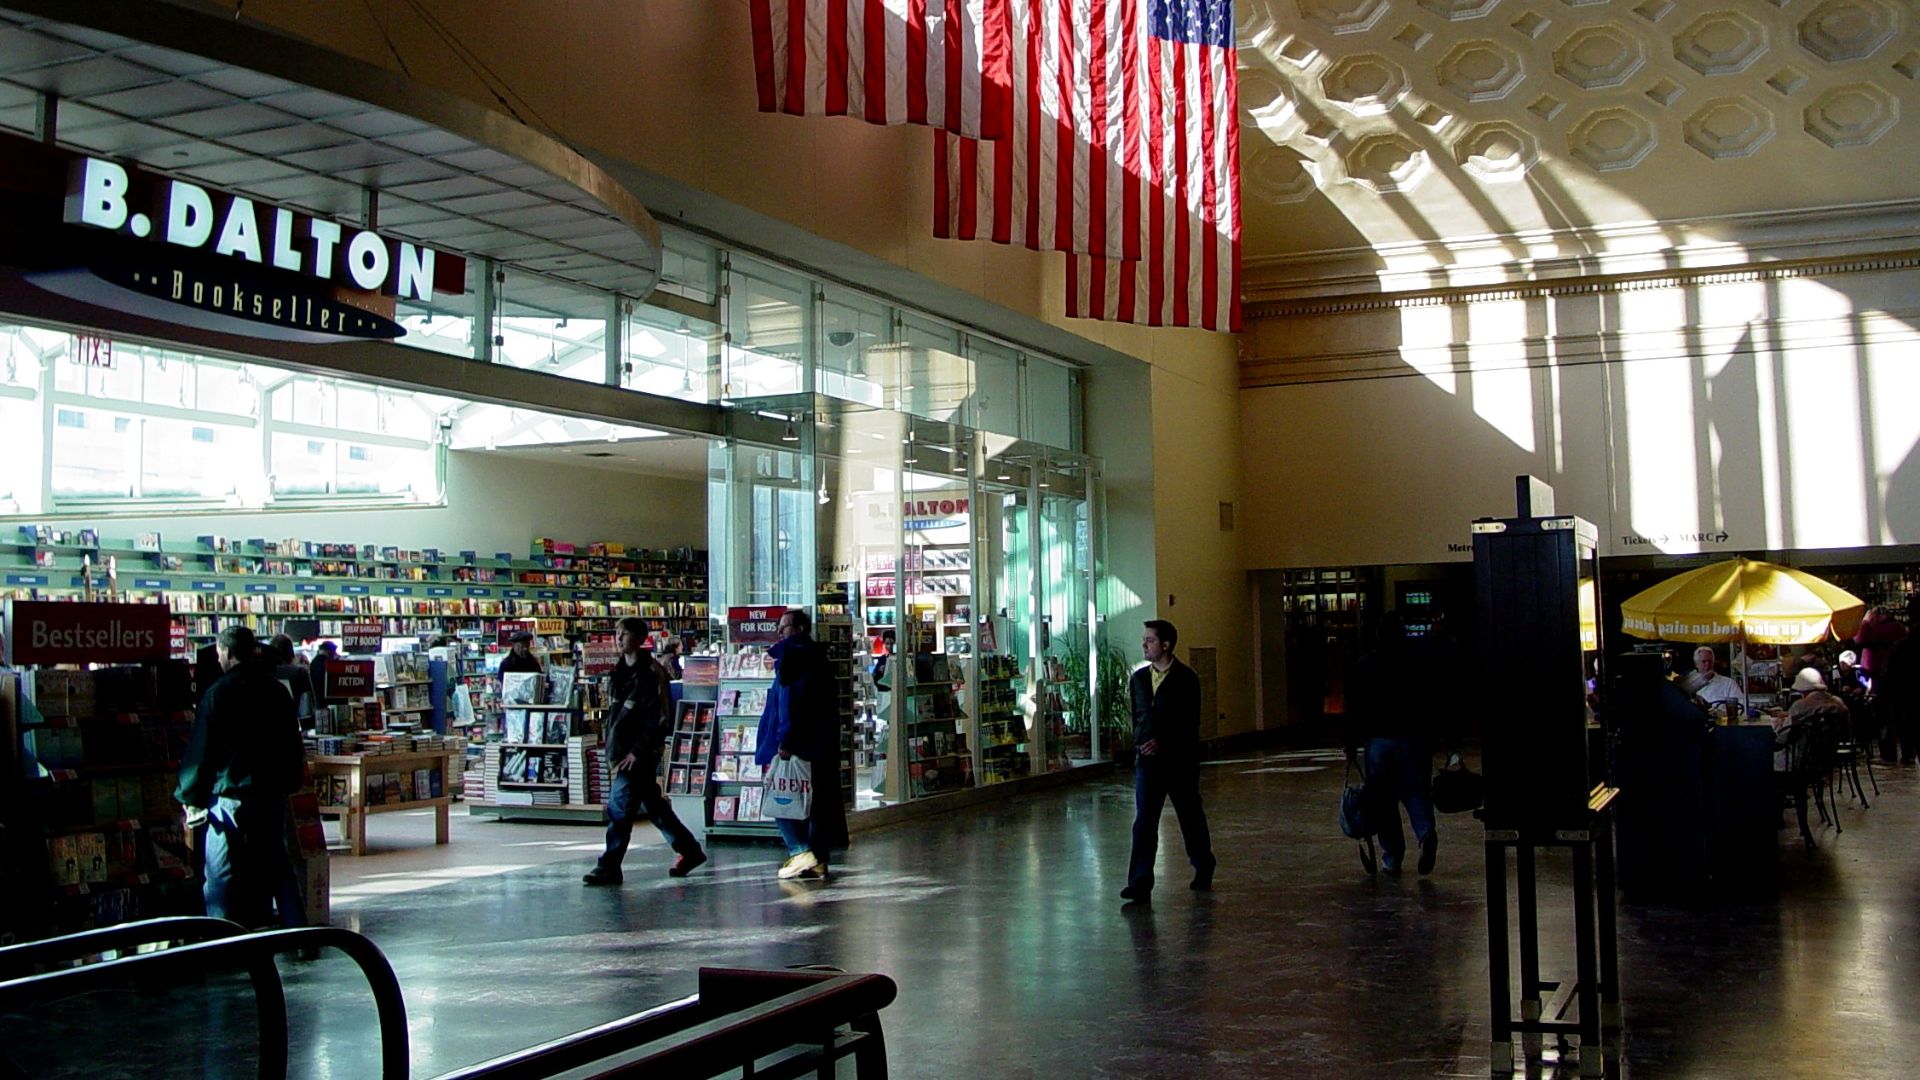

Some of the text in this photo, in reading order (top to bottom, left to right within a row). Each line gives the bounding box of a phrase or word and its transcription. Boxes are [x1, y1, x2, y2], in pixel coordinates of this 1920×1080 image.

[749, 610, 767, 619] NEW
[539, 621, 563, 632] KLUTZ
[740, 621, 777, 632] FOR KIDS
[1659, 620, 1688, 636] pain
[1692, 624, 1710, 635] au
[32, 620, 154, 649] Bestsellers
[344, 636, 380, 646] GIFT BOOKS
[344, 665, 360, 674] NEW
[338, 676, 364, 687] FICTION
